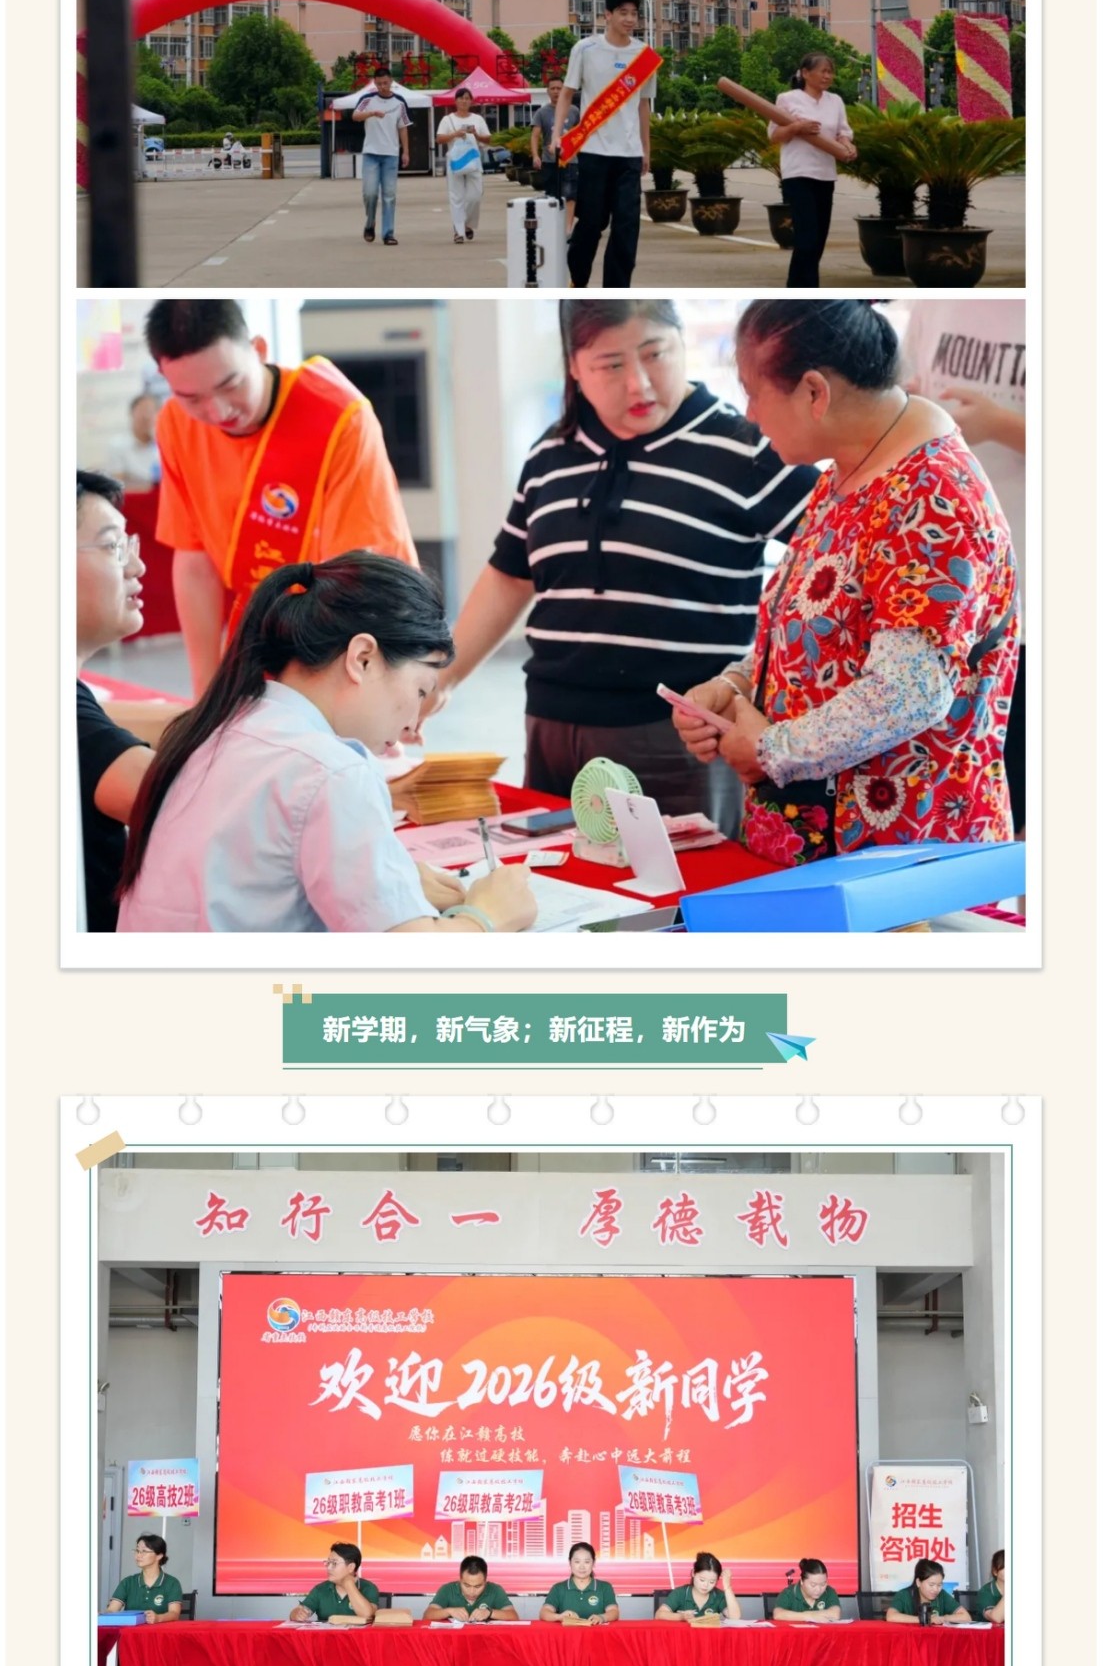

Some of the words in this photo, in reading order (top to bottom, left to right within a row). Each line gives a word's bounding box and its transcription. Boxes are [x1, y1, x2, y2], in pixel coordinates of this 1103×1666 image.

[931, 332, 1026, 387] MOUNTT
[195, 1190, 502, 1242] 知行合一
[579, 1189, 869, 1248] 厚德载物
[307, 1347, 770, 1440] 欢迎2026级新同学
[407, 1425, 526, 1443] 愿你在江赣高技
[132, 1483, 195, 1508] 26级高技2班
[313, 1488, 407, 1515] 26级职教高考1班
[443, 1492, 534, 1514] 26级职教高考2班
[628, 1491, 698, 1516] 26级职教高考3班
[892, 1502, 943, 1529] 招生
[880, 1536, 956, 1563] 咨询处
